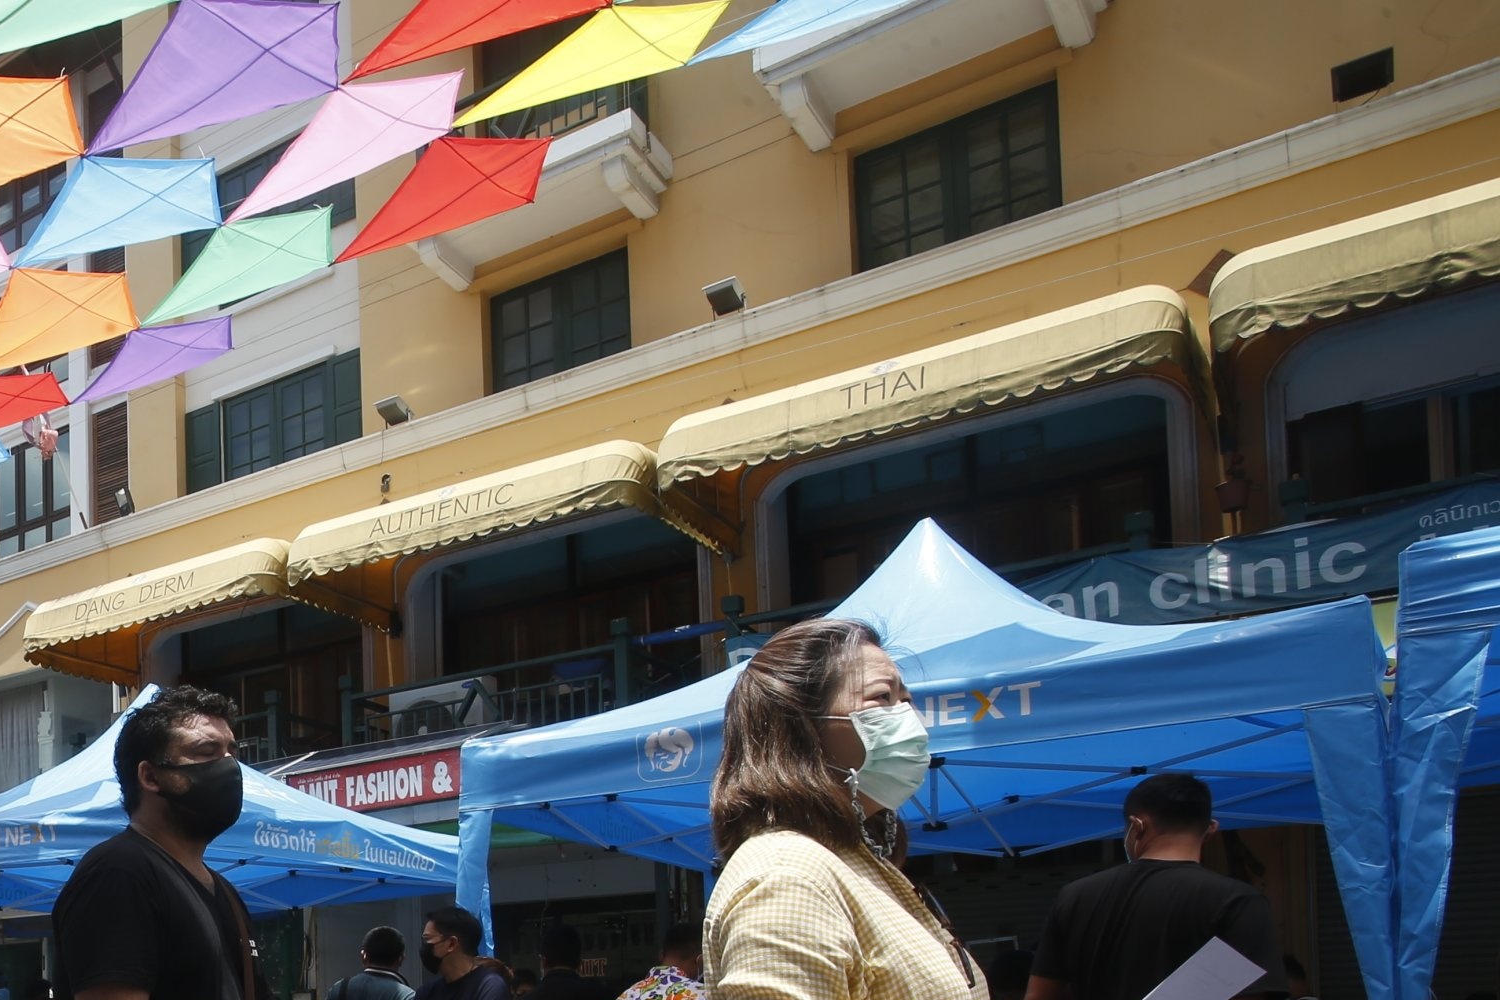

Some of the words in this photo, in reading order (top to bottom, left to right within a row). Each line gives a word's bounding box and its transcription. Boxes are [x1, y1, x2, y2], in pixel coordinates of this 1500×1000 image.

[840, 366, 924, 409] THAI
[369, 483, 514, 538] AUTHENTIC
[74, 592, 125, 621] DANG
[139, 571, 194, 603] DERM
[1149, 536, 1367, 610] clinic
[915, 681, 1041, 728] NEXT
[345, 765, 423, 807] FASHION
[432, 761, 454, 794] &
[5, 823, 57, 848] NEXT
